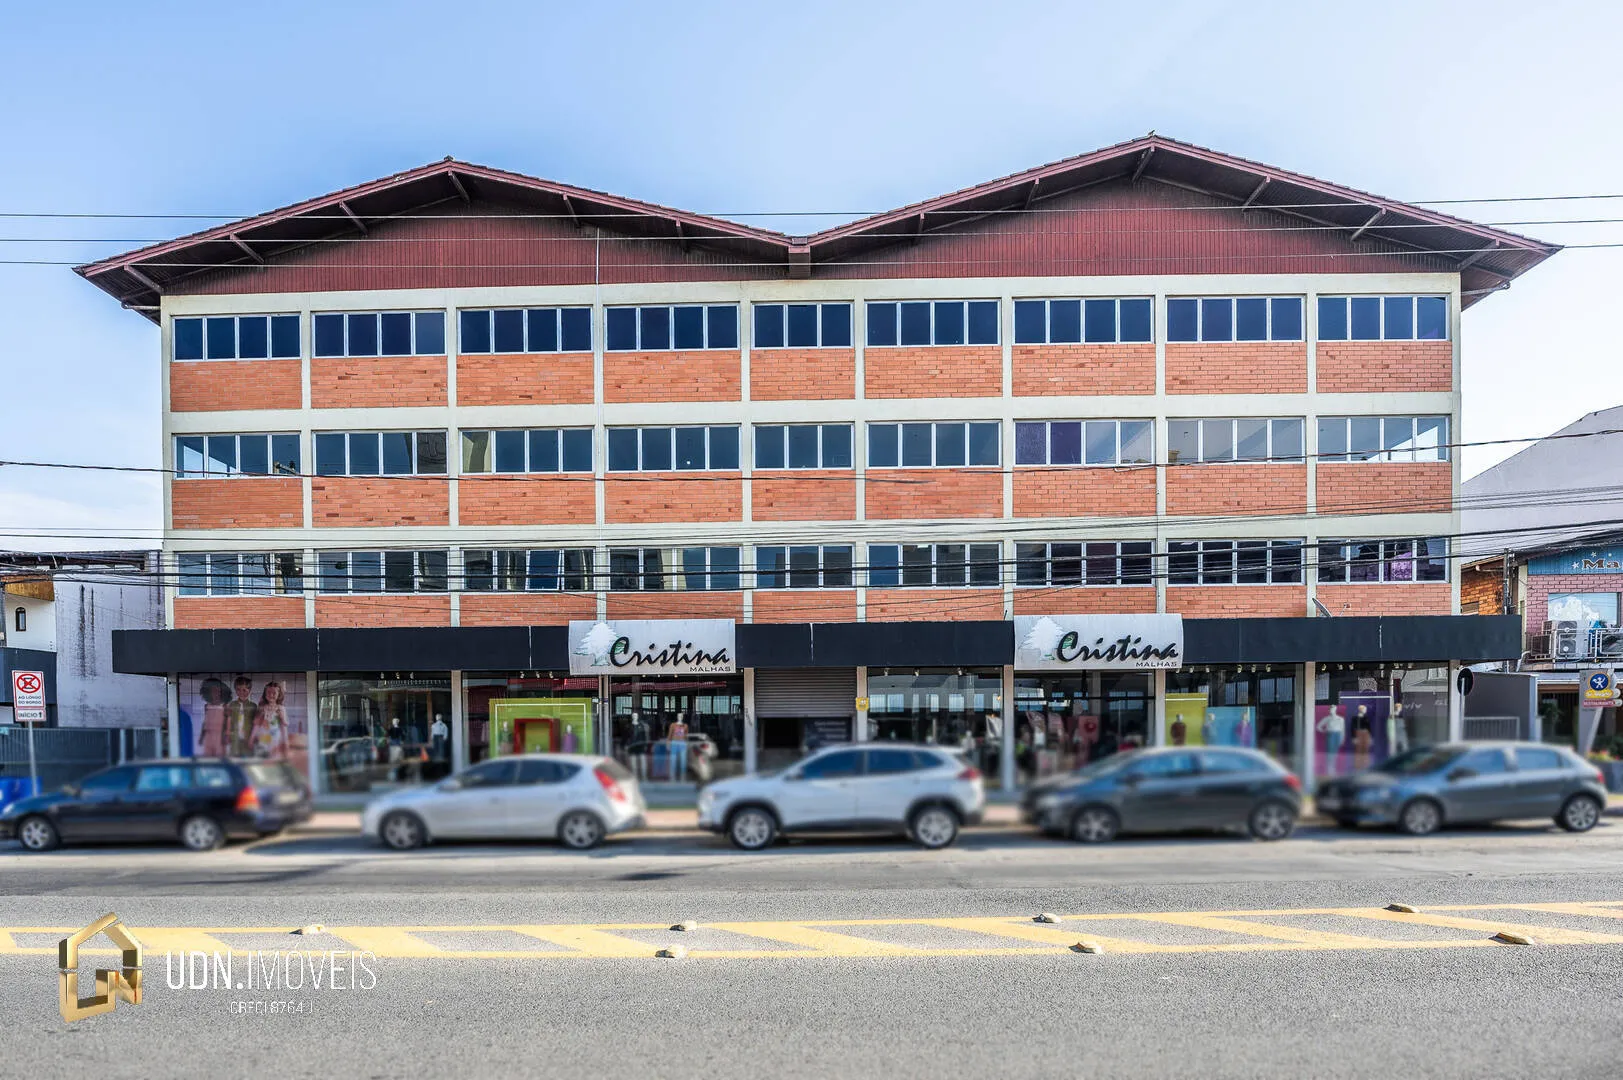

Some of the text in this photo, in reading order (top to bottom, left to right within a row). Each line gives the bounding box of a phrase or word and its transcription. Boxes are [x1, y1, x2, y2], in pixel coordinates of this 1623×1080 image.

[1582, 558, 1623, 570] Ma
[609, 636, 731, 667] Cristina
[1056, 631, 1179, 662] Cristina
